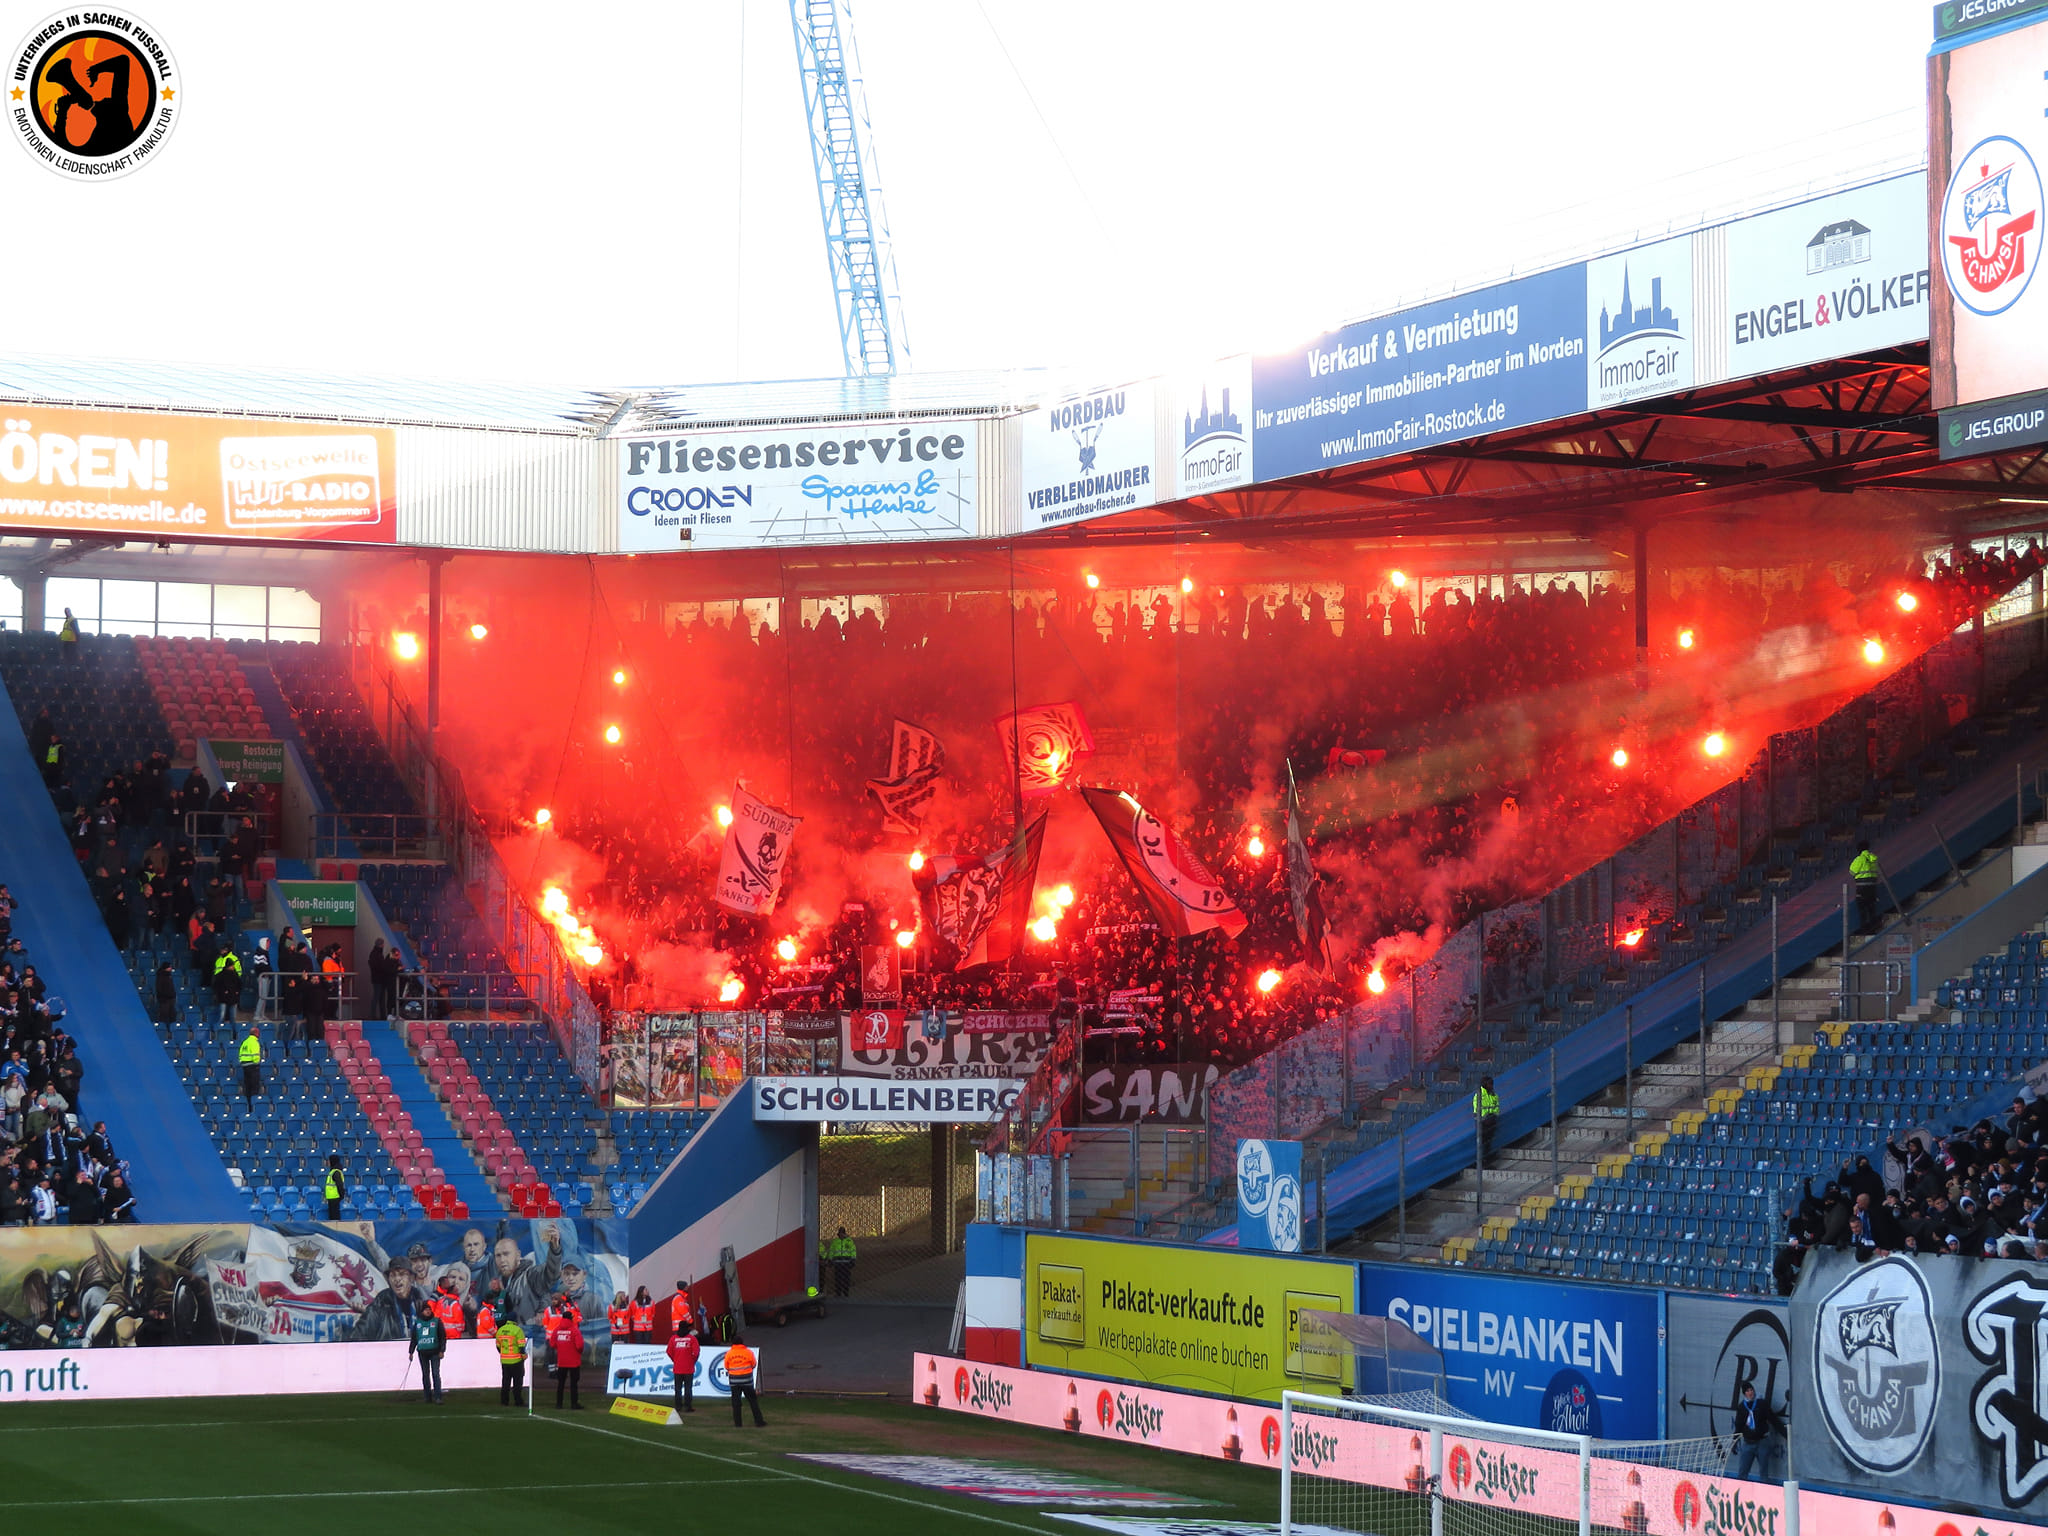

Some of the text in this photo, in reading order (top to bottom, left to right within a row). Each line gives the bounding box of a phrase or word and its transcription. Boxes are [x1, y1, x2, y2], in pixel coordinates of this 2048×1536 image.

[1308, 303, 1519, 378] Verkauf & Vermietung
[1256, 336, 1584, 430] Ihr zuverlässiger Immobilien-Partner im Norden
[1600, 346, 1679, 389] ImmoFair
[1050, 391, 1126, 432] NORDBAU
[1321, 399, 1506, 459] www.ImmoFair-Rostock.de
[1964, 409, 2045, 442] JES.GROUP
[229, 450, 369, 472] Ostseewelle
[627, 427, 965, 476] Fliesenservice
[1184, 446, 1242, 482] ImmoFair
[913, 468, 940, 497] &
[1028, 464, 1151, 510] VERBLENDMAURER
[627, 484, 752, 517] CROONEN
[840, 497, 937, 520] Henke
[1041, 491, 1137, 523] www.nordbau-fischer.de
[654, 512, 732, 527] Ideen mit Fliesen
[242, 759, 282, 773] Reinigung
[243, 744, 282, 756] Rostocker
[1142, 835, 1164, 857] FC
[895, 1064, 1014, 1080] SANKT PAULI
[1042, 1281, 1081, 1304] Plakat-
[1102, 1279, 1265, 1329] Plakat-verkauft.de
[269, 1309, 292, 1337] JA
[1043, 1307, 1082, 1323] verkauft.de
[1098, 1326, 1269, 1371] Werbeplakate online buchen
[1388, 1297, 1623, 1377] SPIELBANKEN
[25, 1357, 90, 1392] ruft.
[970, 1368, 1013, 1413] Lübzer
[1484, 1367, 1516, 1398] MV
[1115, 1390, 1164, 1439] Lübzer
[1474, 1447, 1539, 1503] Lübzer
[1704, 1483, 1779, 1536] Lübzer
